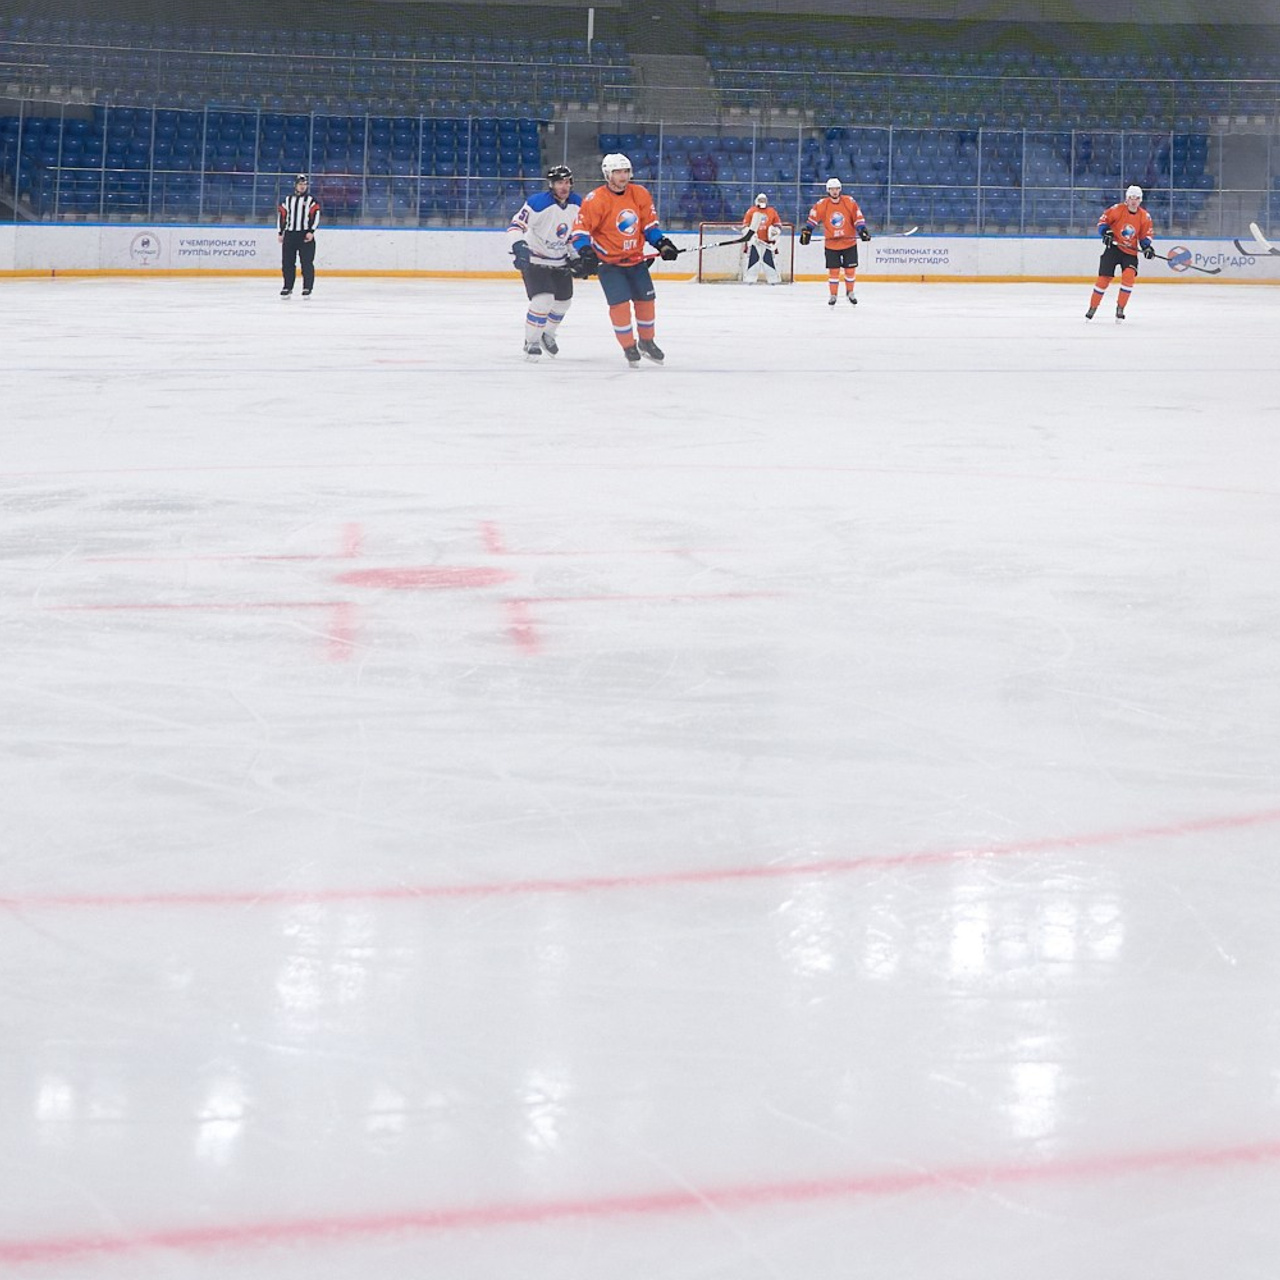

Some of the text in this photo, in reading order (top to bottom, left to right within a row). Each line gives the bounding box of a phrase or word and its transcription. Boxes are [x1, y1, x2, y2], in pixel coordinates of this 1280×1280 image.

[187, 239, 237, 247] ЧЕМПИОНАТ
[239, 239, 256, 247] КХЛ
[213, 249, 256, 257] РУСГИДРО
